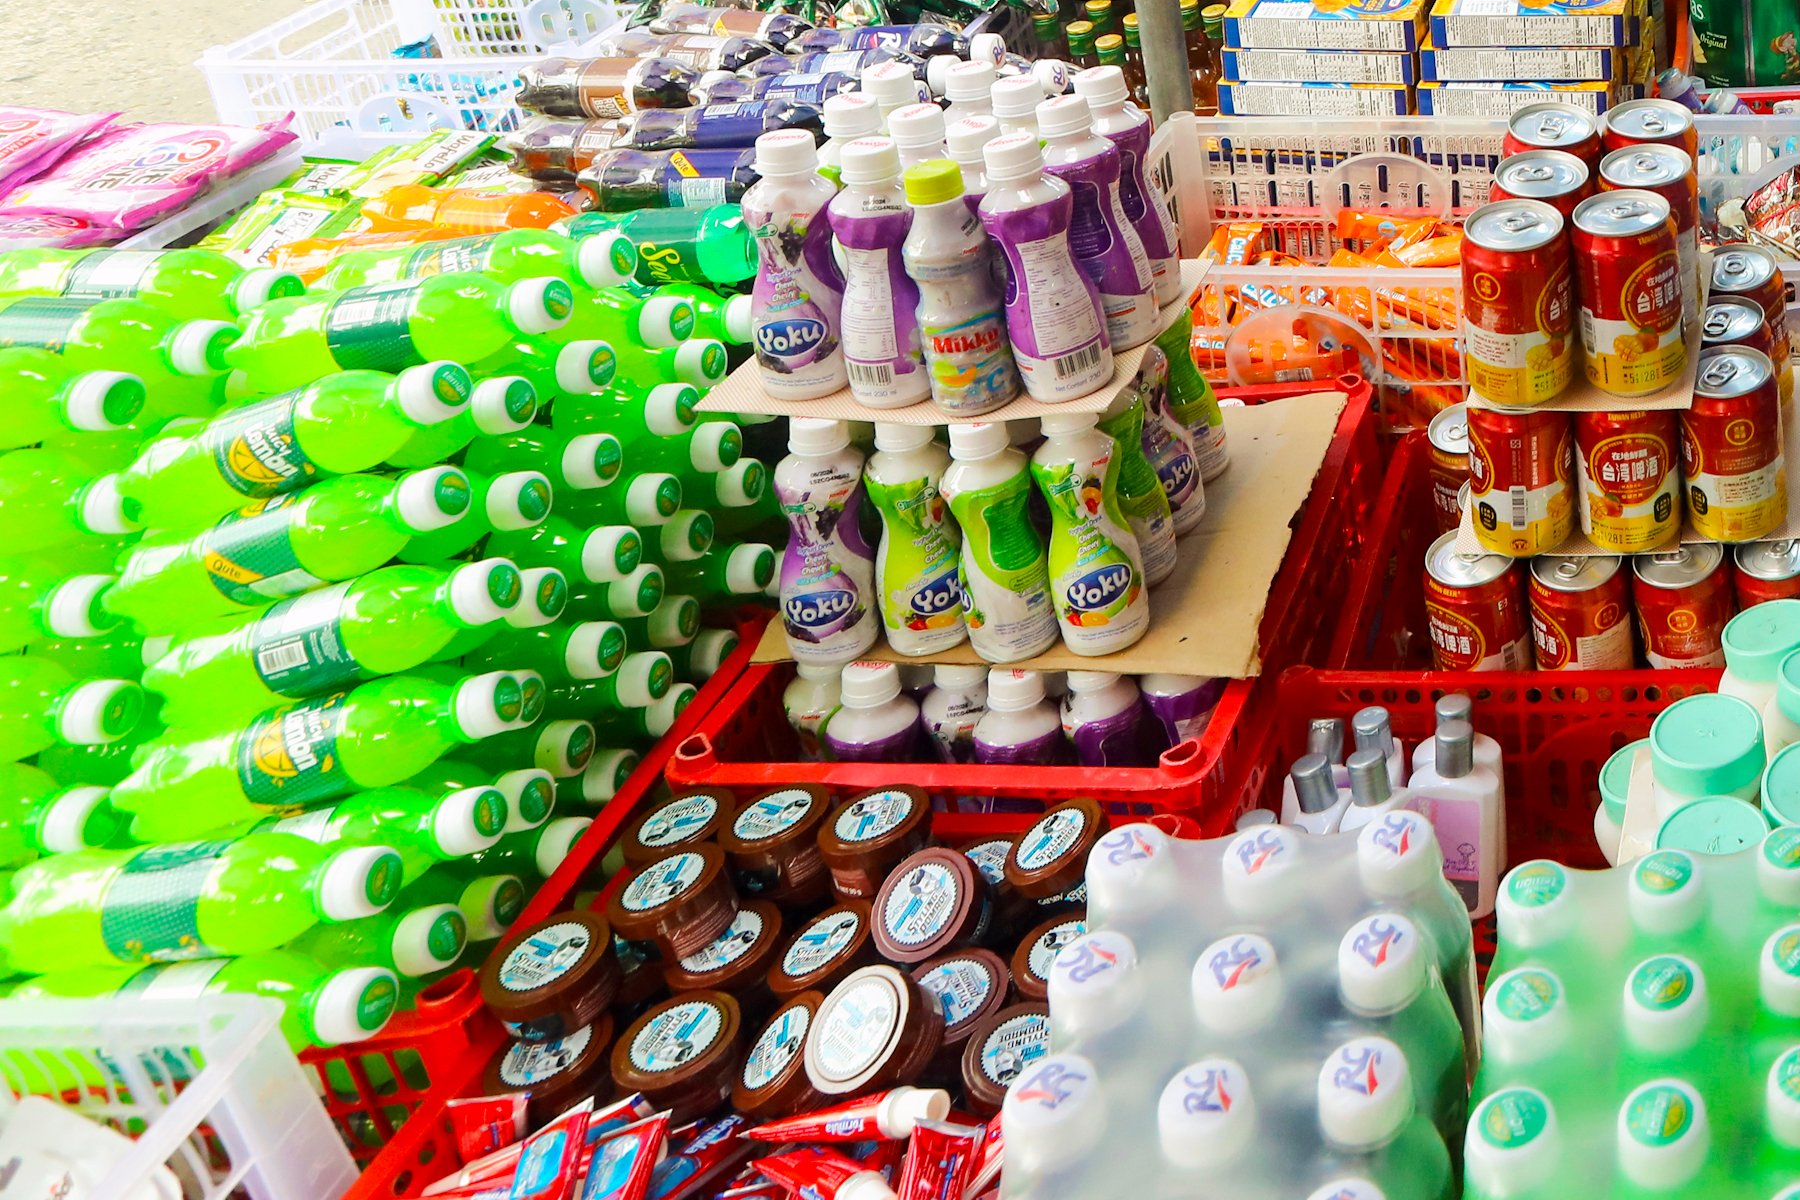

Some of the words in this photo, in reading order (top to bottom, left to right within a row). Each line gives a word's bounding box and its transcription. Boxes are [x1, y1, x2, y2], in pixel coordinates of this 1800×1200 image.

[1699, 32, 1728, 50] Original
[757, 323, 821, 353] Yoku
[932, 328, 1000, 354] Mikku
[873, 389, 888, 397] 230
[243, 424, 300, 478] Lemon
[212, 560, 243, 579] Qute
[801, 563, 827, 575] Chewy
[804, 553, 828, 565] Chewy
[913, 576, 961, 611] Yok
[1069, 568, 1130, 605] Yoku
[786, 594, 852, 623] Yoku
[1035, 827, 1069, 863] STYLING
[1046, 825, 1078, 860] POMADE
[1101, 829, 1153, 866] RC
[1236, 829, 1284, 874] RC
[1372, 813, 1418, 856] RC
[907, 890, 940, 934] STYLING
[920, 889, 950, 934] POMADE
[1352, 917, 1403, 967] RC
[1056, 940, 1117, 983] RC
[1208, 937, 1261, 991] RC
[655, 1010, 690, 1056] STYLING
